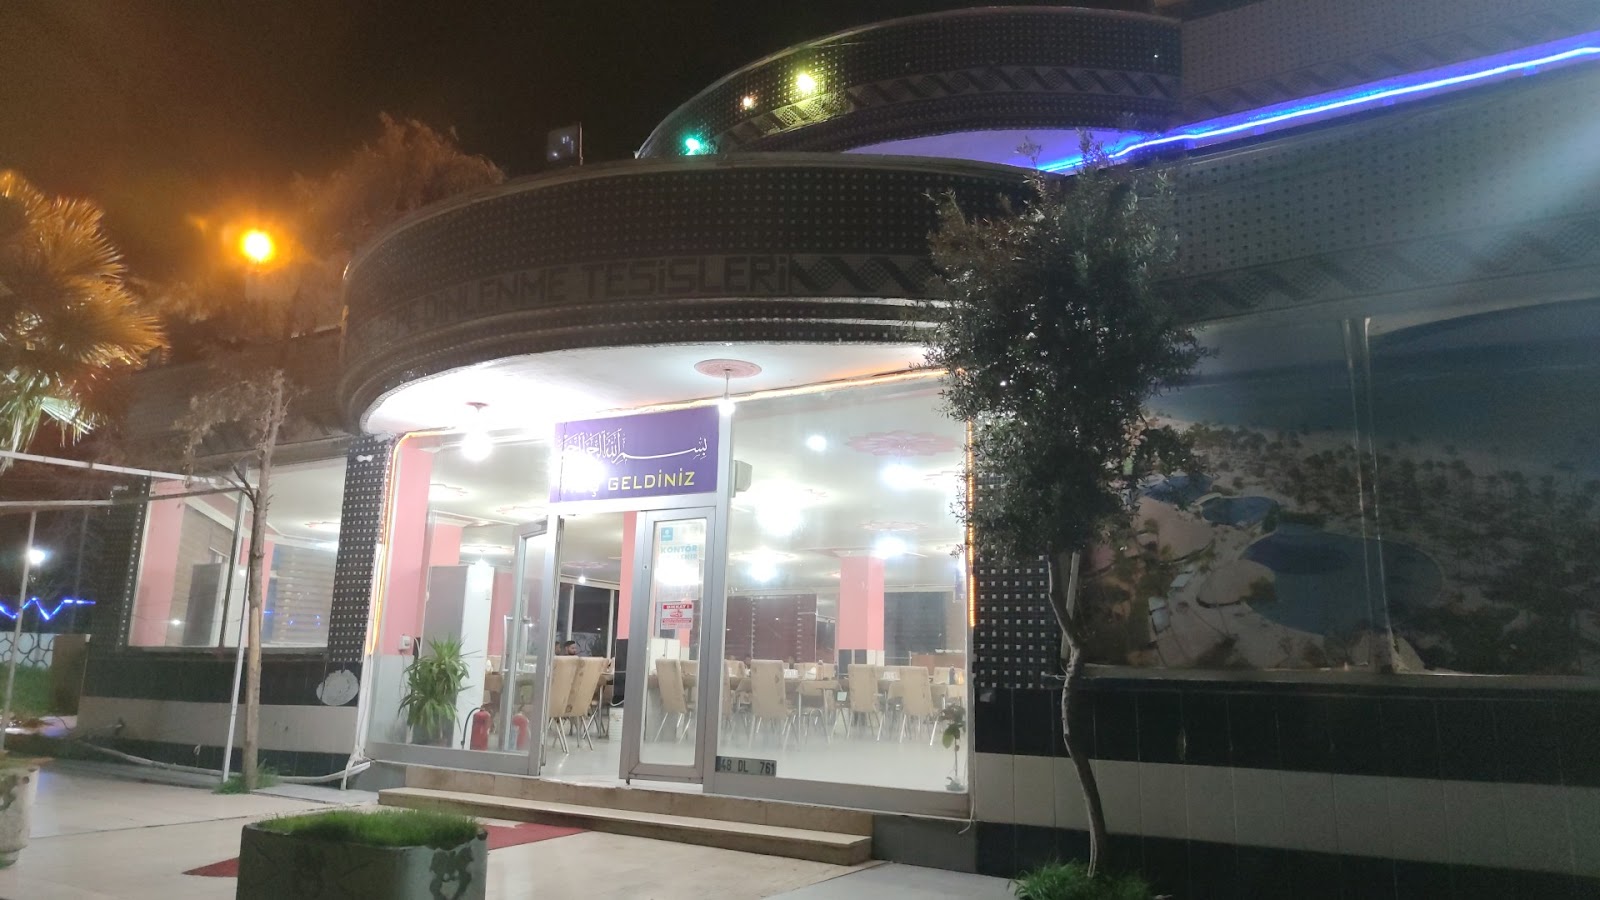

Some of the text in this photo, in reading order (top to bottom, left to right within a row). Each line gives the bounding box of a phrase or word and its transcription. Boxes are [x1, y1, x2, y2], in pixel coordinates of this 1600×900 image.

[581, 256, 786, 298] TESİSLERİ
[608, 468, 695, 491] GELDİNİZ
[721, 759, 732, 771] 48
[738, 760, 748, 773] DL
